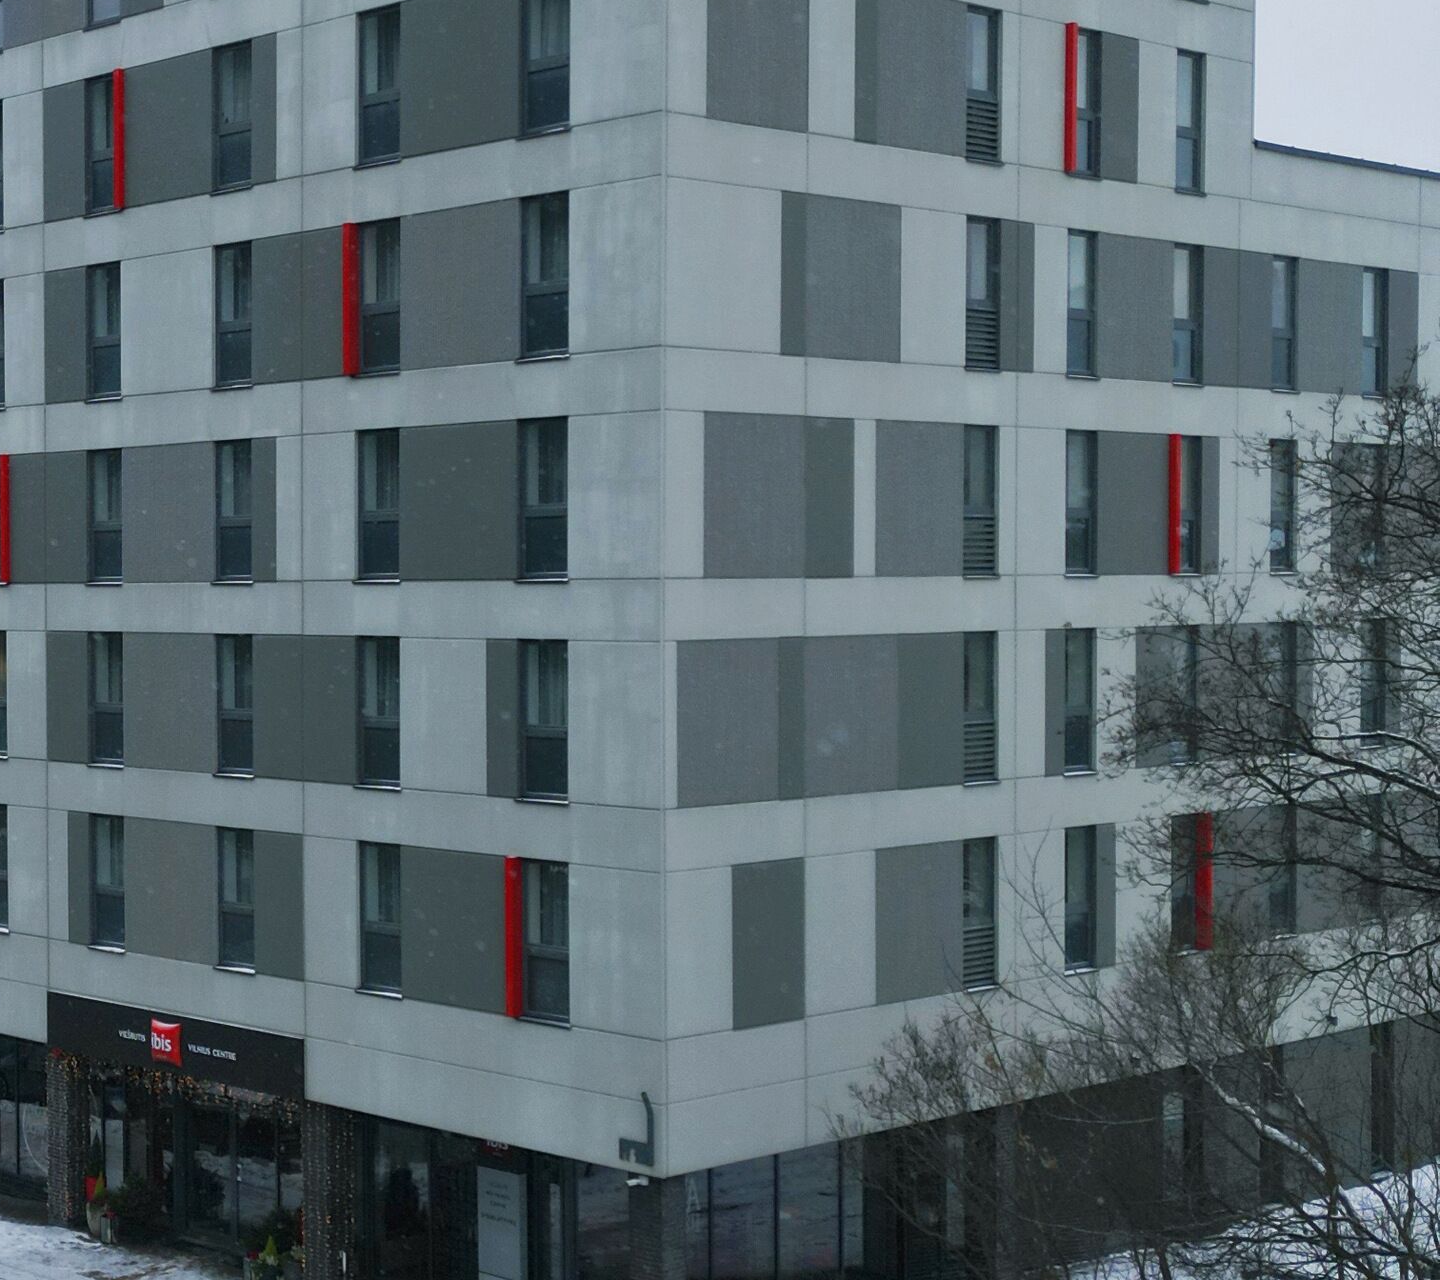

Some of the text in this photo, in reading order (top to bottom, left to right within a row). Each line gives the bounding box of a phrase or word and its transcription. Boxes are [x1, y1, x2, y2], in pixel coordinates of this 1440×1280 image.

[151, 1031, 172, 1052] ibis
[187, 1043, 211, 1056] VILNIUS
[211, 1047, 237, 1061] CENTRE
